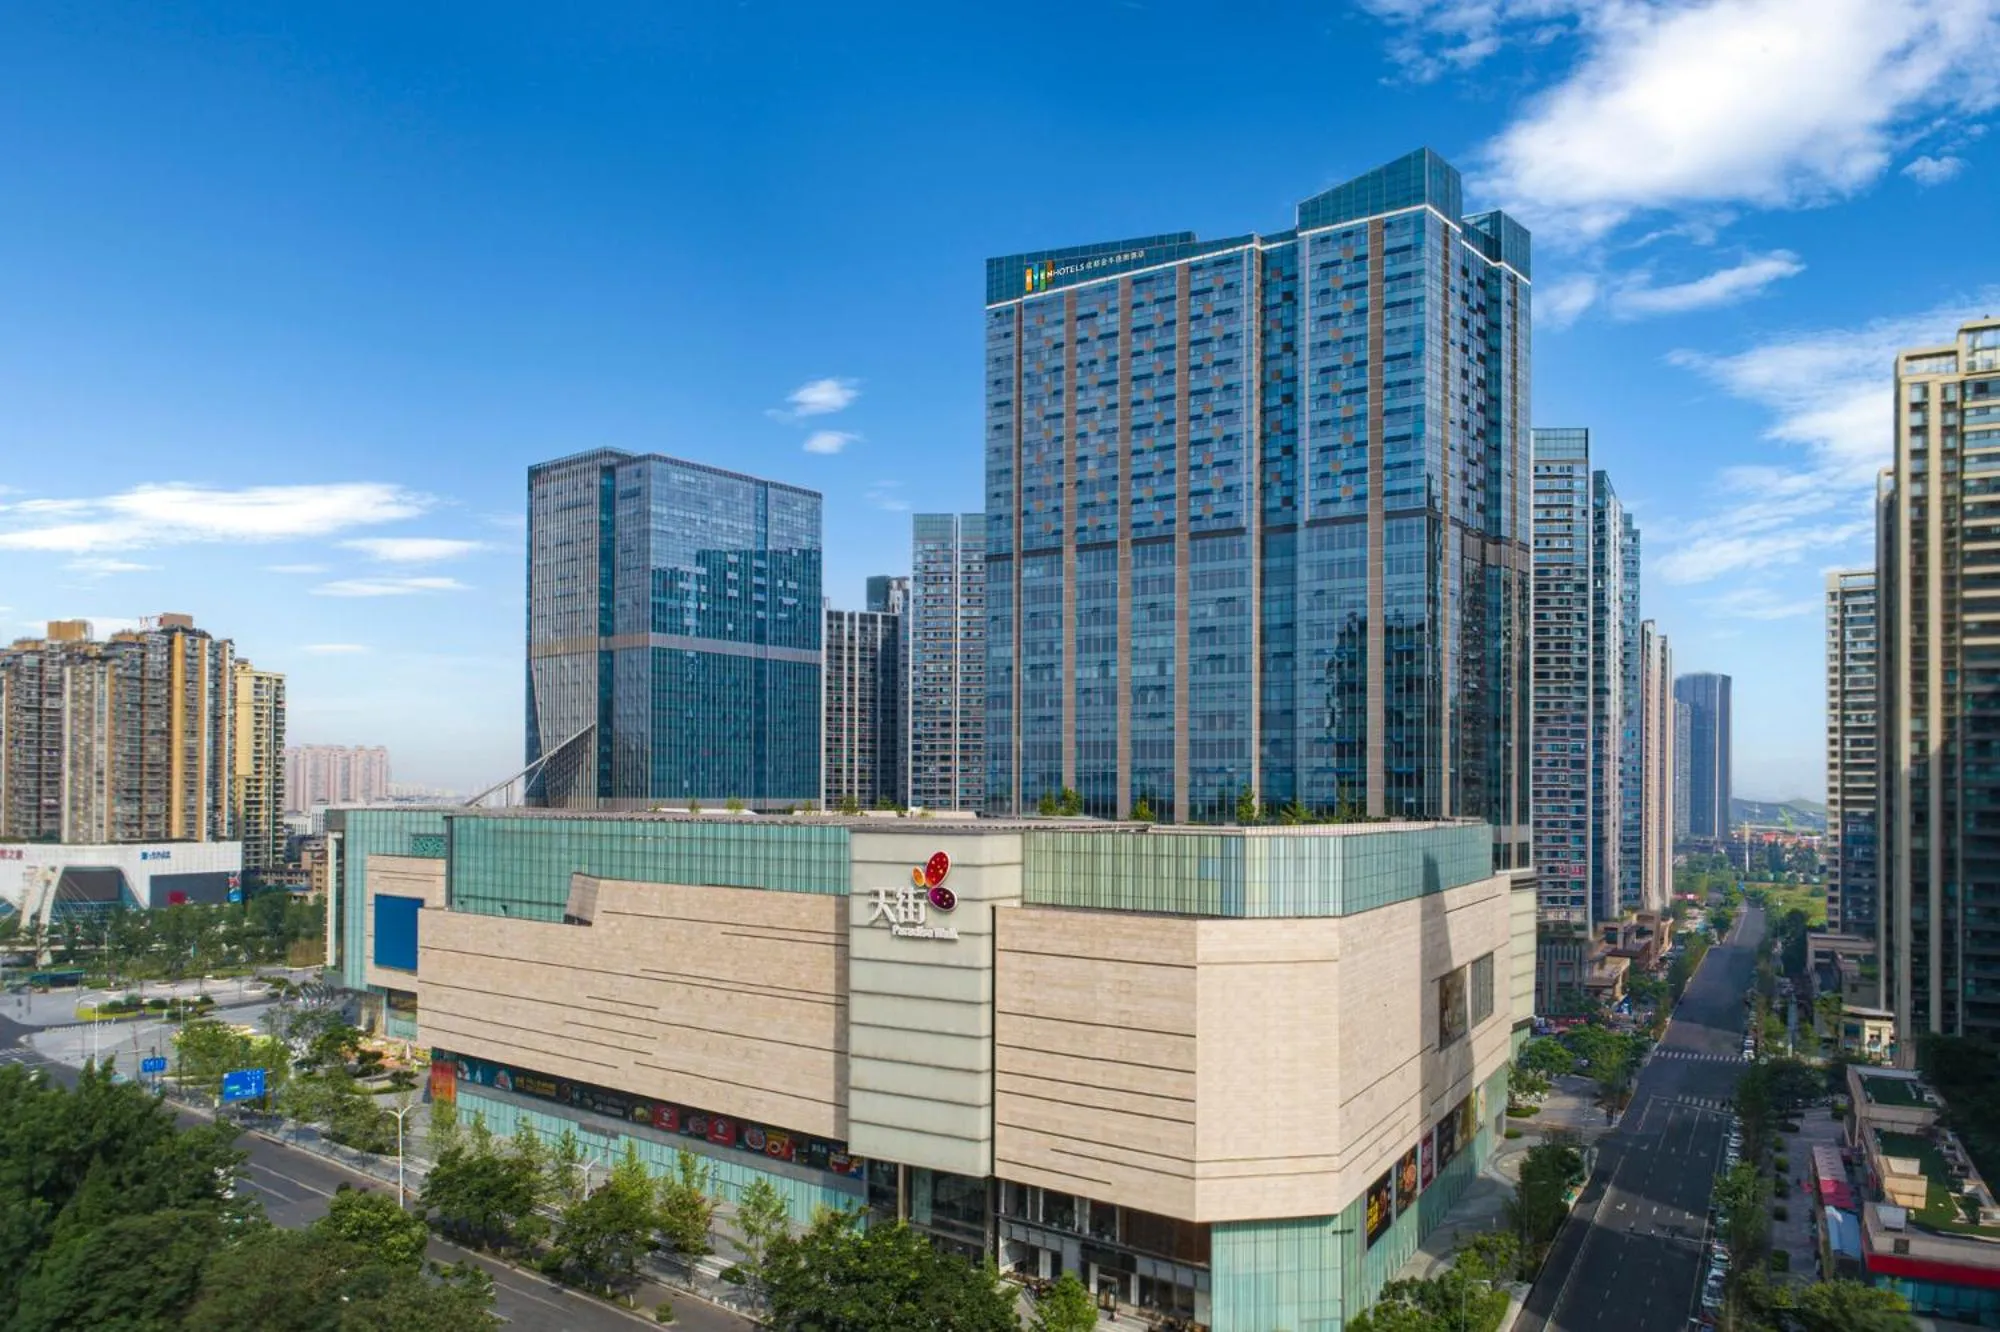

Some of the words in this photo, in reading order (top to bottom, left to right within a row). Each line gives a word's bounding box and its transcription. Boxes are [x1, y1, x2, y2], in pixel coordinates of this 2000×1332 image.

[1053, 263, 1085, 277] HOTELS
[868, 887, 927, 924] 天街
[892, 924, 933, 938] Paradise
